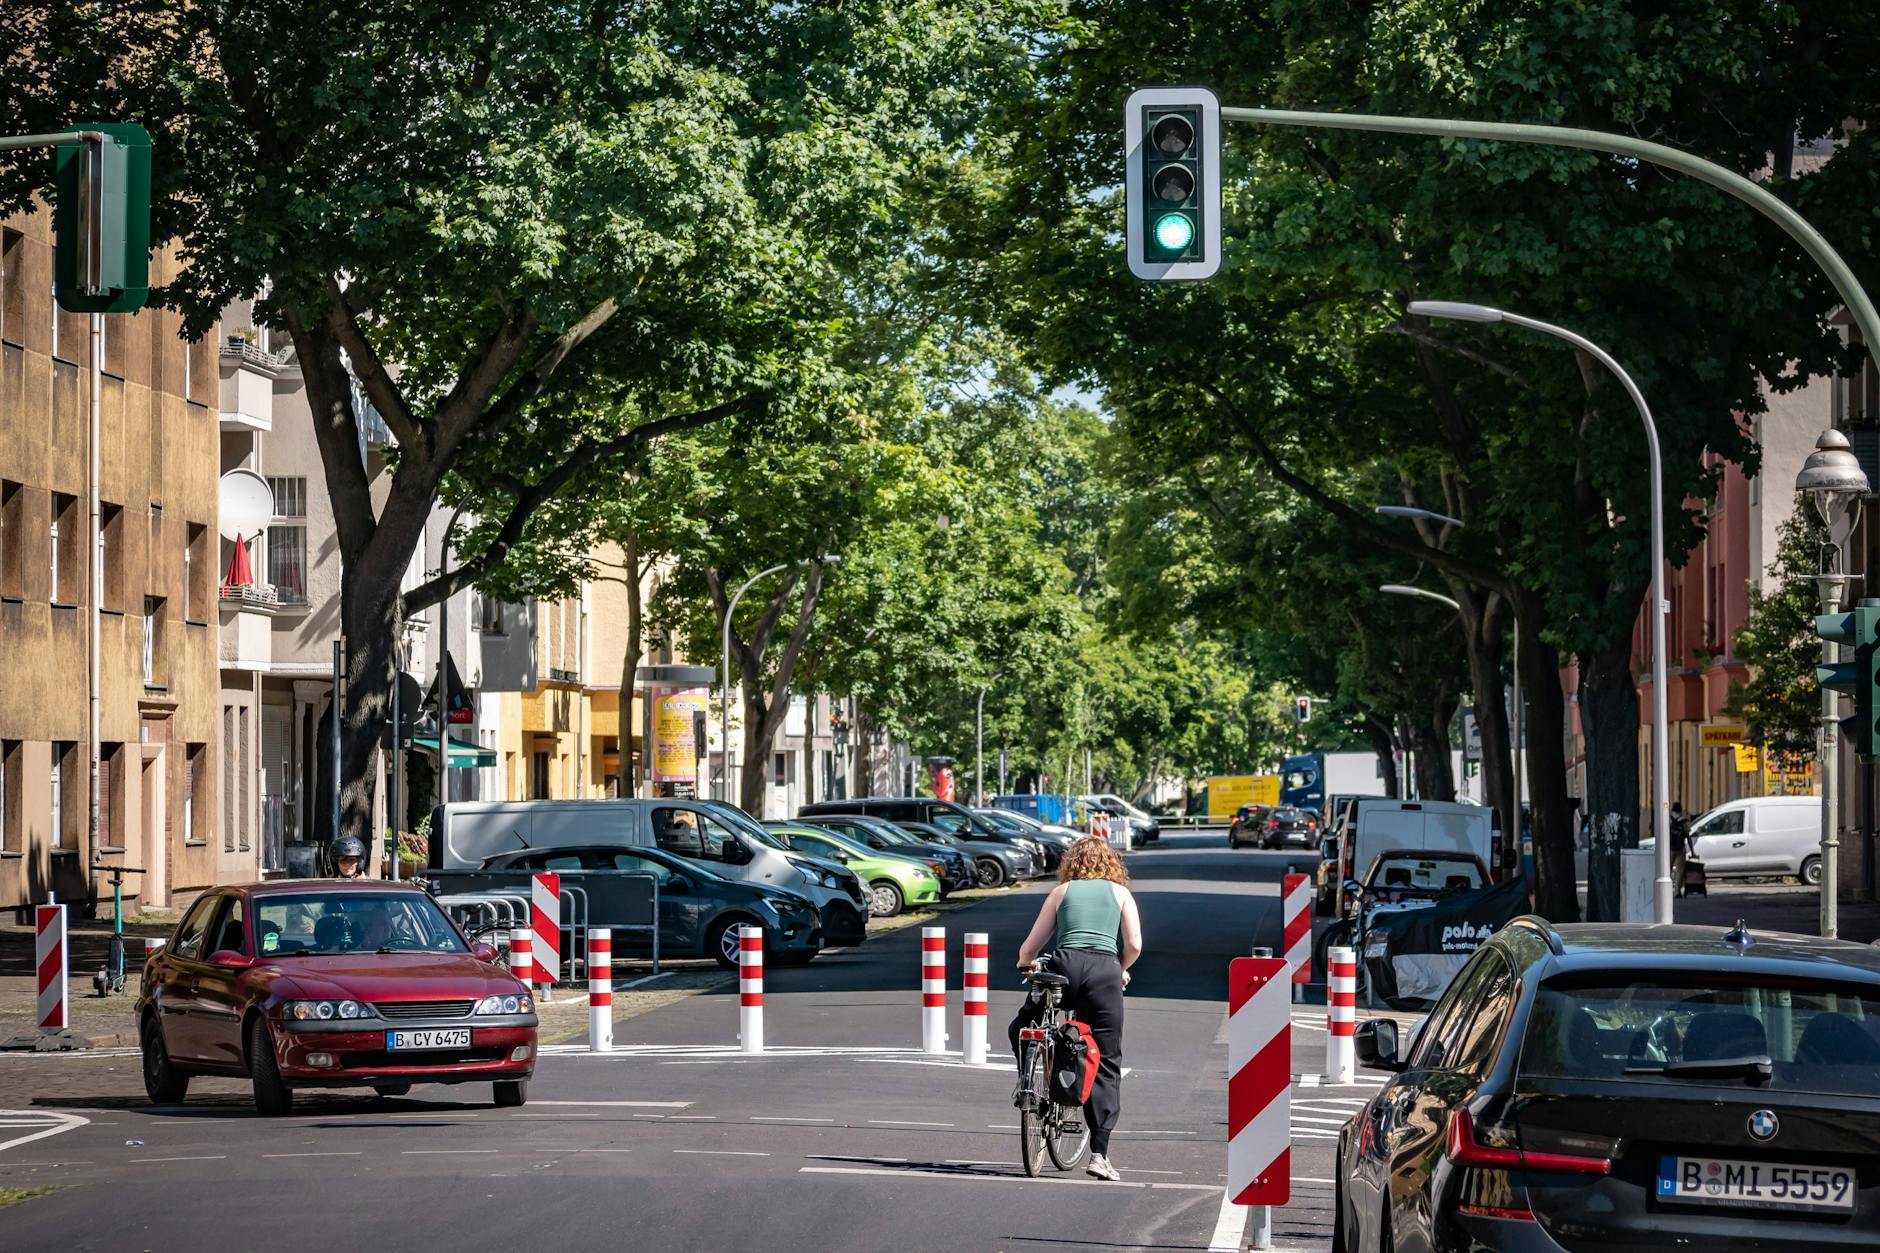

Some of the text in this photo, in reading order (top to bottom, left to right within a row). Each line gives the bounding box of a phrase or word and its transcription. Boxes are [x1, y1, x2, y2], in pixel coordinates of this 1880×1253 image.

[1441, 921, 1475, 942] polo
[396, 1033, 404, 1047] B
[414, 1032, 431, 1046] CY
[435, 1031, 469, 1045] 6475
[1682, 1162, 1850, 1202] B MI 5559
